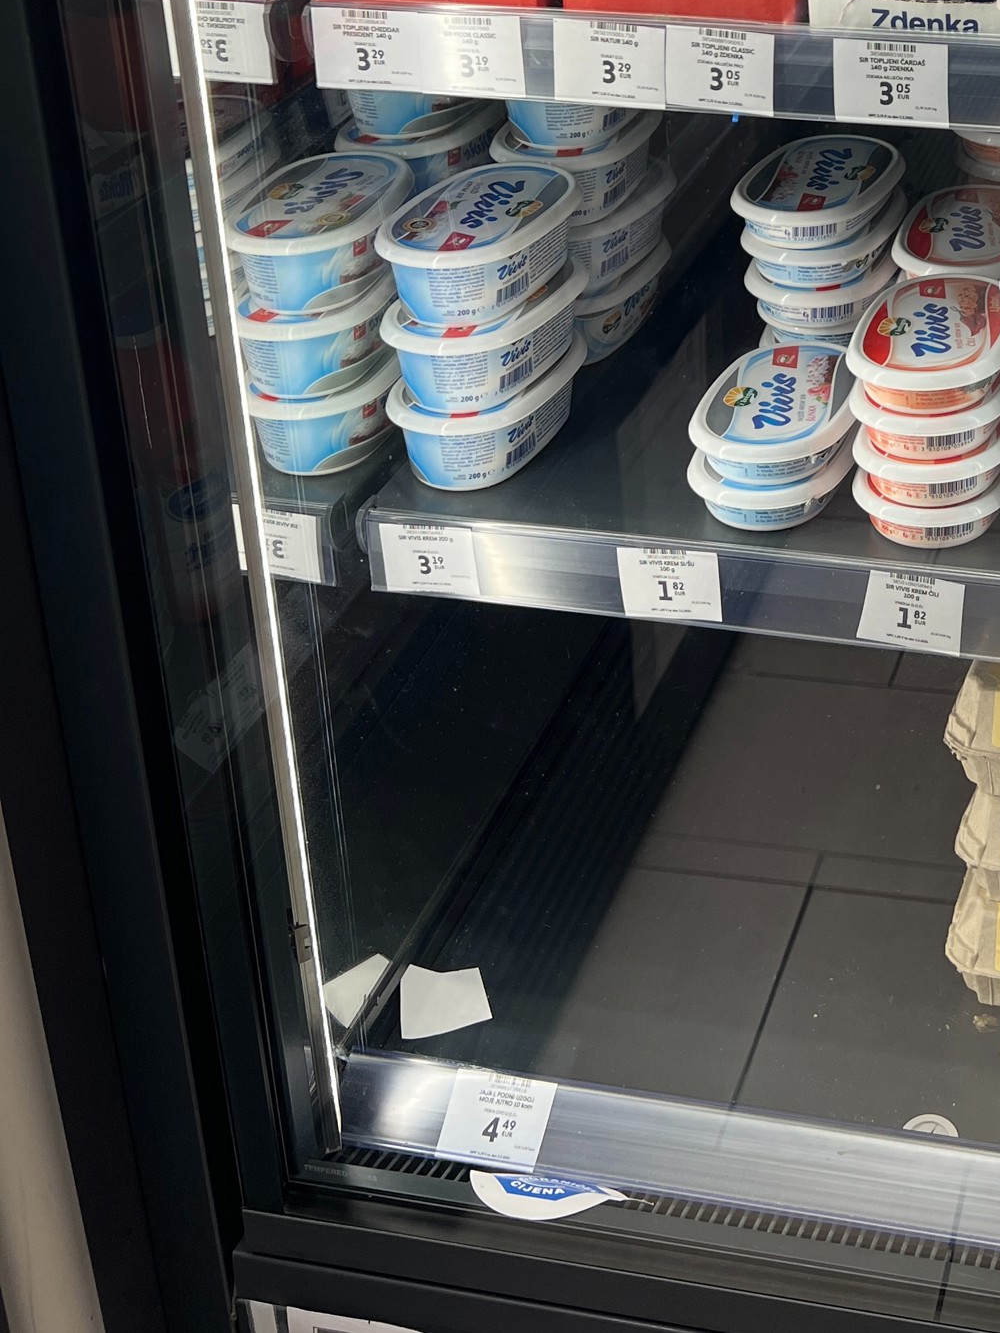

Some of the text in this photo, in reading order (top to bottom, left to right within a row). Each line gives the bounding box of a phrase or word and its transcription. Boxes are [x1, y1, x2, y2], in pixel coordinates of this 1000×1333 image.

[871, 8, 979, 34] Zdenka
[356, 48, 385, 71] 3 29
[460, 54, 488, 77] 3 19
[602, 60, 632, 84] 3 29
[710, 67, 740, 91] 3 05
[879, 81, 911, 105] 3 05
[807, 147, 853, 191] Vivis
[949, 205, 984, 252] Vivis
[911, 302, 952, 357] Vivis
[752, 372, 797, 430] Vivis
[418, 555, 444, 574] 3 19
[658, 580, 685, 601] 1 82
[897, 607, 926, 629] 1 82
[481, 1117, 516, 1142] 4 49
[510, 1179, 565, 1195] CIJENA
